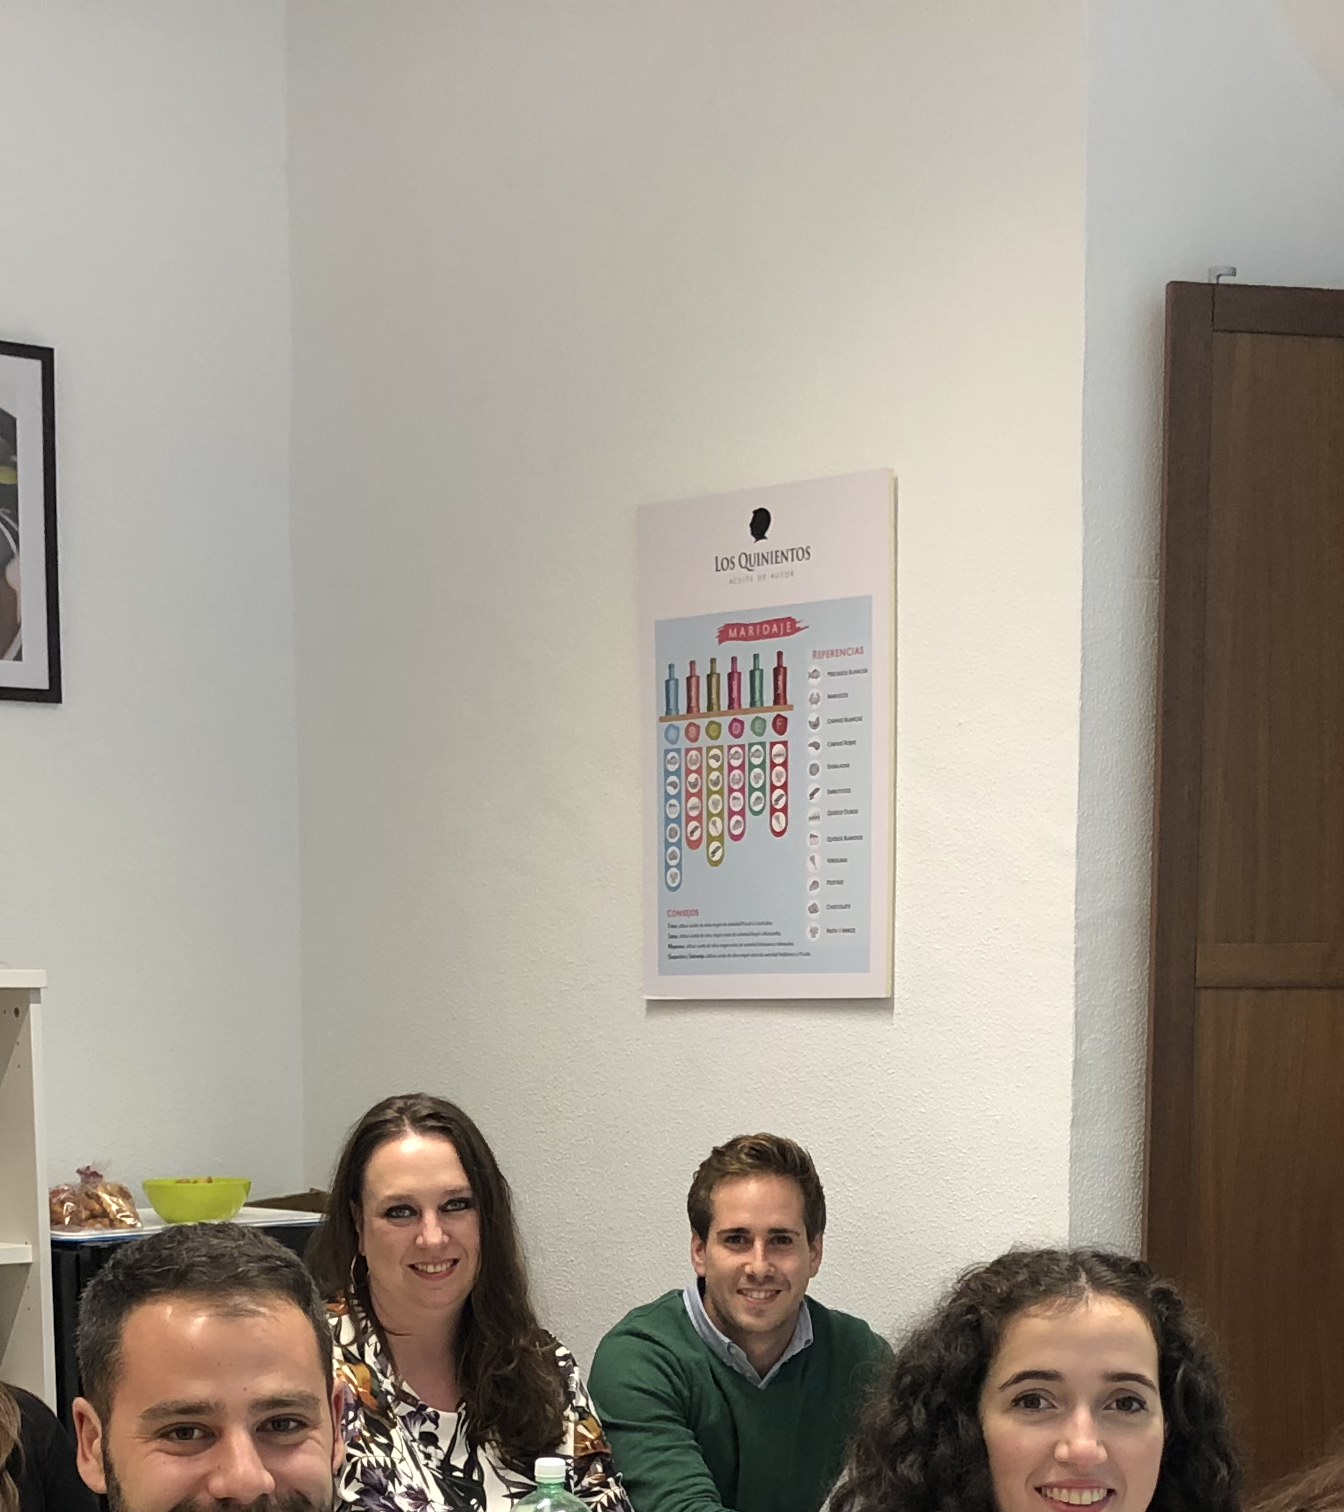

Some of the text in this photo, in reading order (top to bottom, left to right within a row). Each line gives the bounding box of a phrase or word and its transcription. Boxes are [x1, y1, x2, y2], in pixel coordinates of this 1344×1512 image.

[715, 546, 811, 572] LOS QUINIENTOS
[728, 621, 792, 638] MARIDAJE
[812, 646, 864, 659] REFERENCIAS
